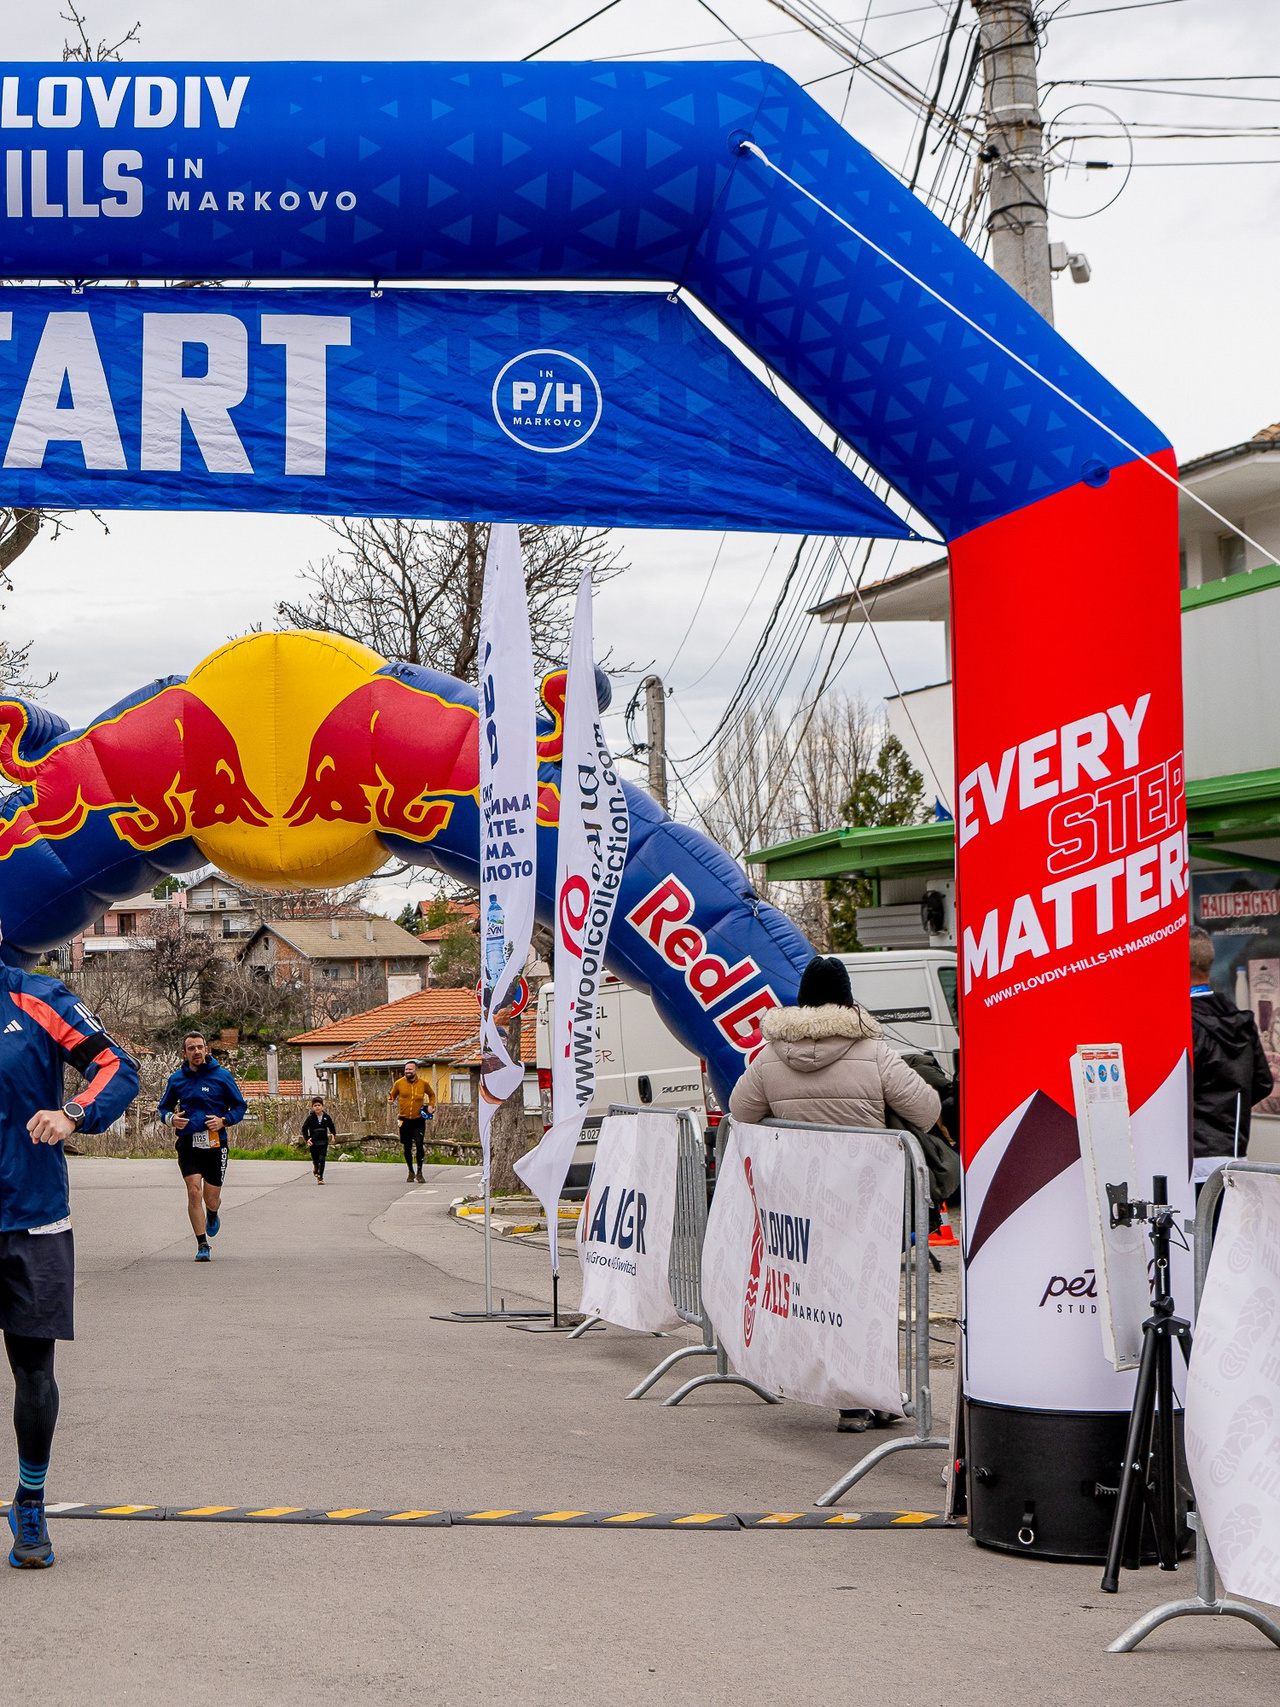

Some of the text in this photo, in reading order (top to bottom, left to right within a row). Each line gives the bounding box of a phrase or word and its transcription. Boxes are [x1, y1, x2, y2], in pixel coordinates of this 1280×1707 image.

[167, 158, 204, 179] IN
[167, 190, 358, 212] MARKOVO
[539, 370, 554, 378] IN
[512, 381, 582, 415] P/H
[513, 417, 582, 428] MARKOVO
[959, 693, 1151, 849] EVERY
[1047, 750, 1185, 875] STEP
[627, 874, 758, 1009] Red
[983, 913, 1187, 1008] WWW.PLOVDIV-HILLS-IN-MARKOVO.COM
[662, 1084, 700, 1094] DUCATO
[193, 1134, 206, 1143] 1125
[792, 1281, 801, 1296] IN
[792, 1303, 843, 1328] MARKOVO
[1057, 1303, 1097, 1314] STUD
